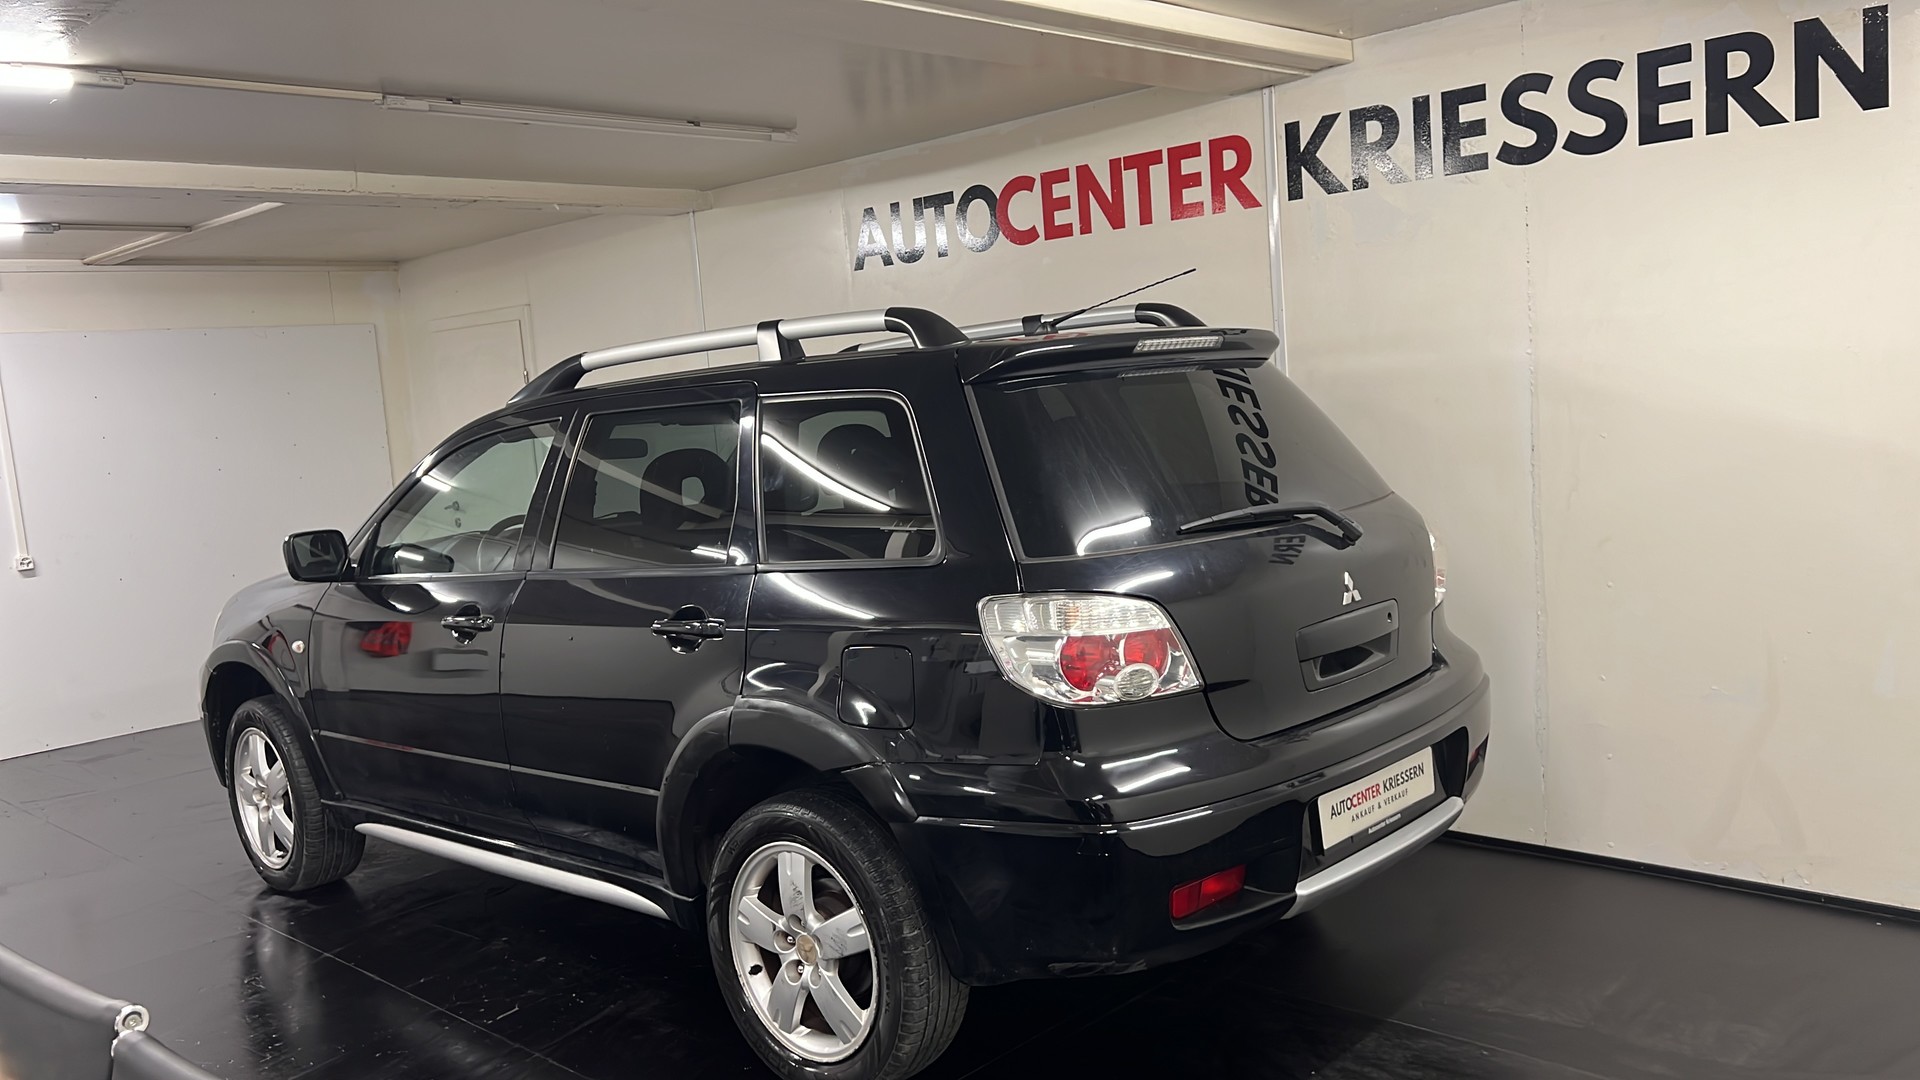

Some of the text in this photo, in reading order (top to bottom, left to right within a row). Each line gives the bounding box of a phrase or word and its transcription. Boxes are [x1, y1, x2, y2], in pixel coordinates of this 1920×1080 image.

[853, 3, 1890, 272] AUTOCENTER KRIESSERN
[1330, 762, 1425, 820] AUTOCENTER KRIESSERN
[1351, 805, 1375, 823] ANKAUF
[1383, 788, 1409, 806] VERKAUF
